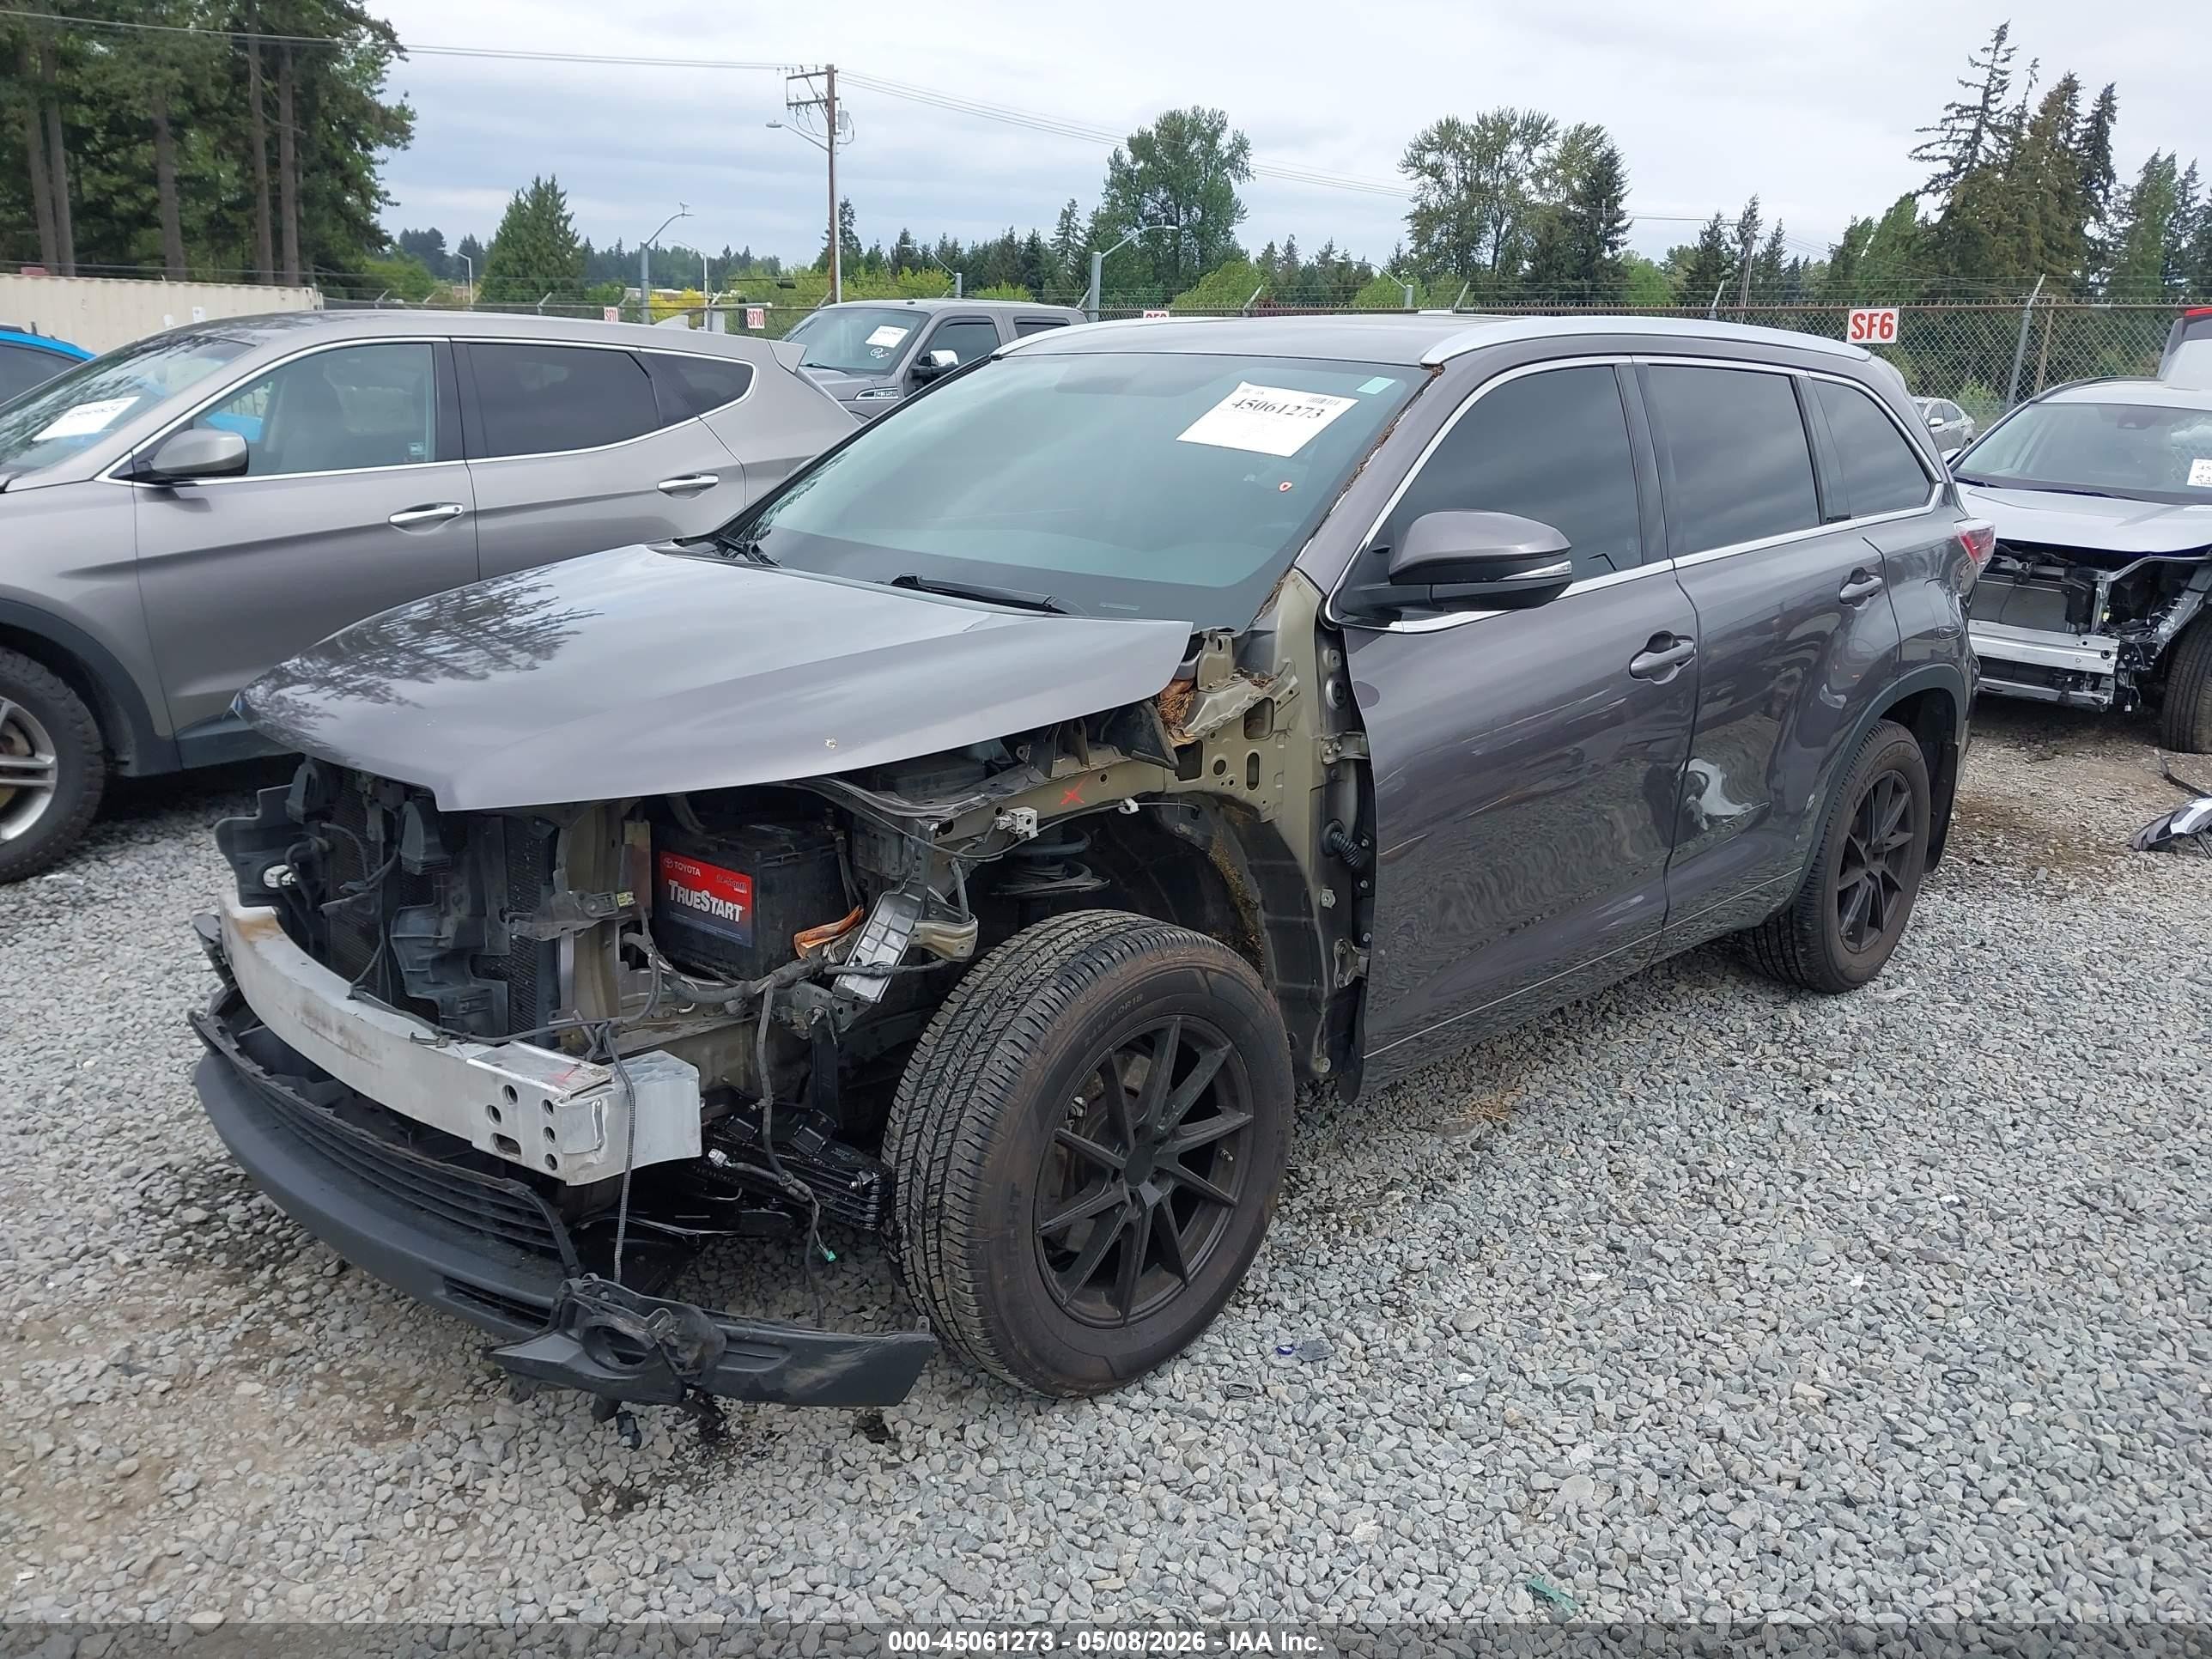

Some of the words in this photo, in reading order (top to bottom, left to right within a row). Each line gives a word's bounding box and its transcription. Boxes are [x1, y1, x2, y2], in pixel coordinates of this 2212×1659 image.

[748, 310, 763, 327] SF10
[1850, 312, 1894, 340] SF6
[1231, 398, 1326, 419] 45061273
[673, 860, 702, 877] TOYOTA
